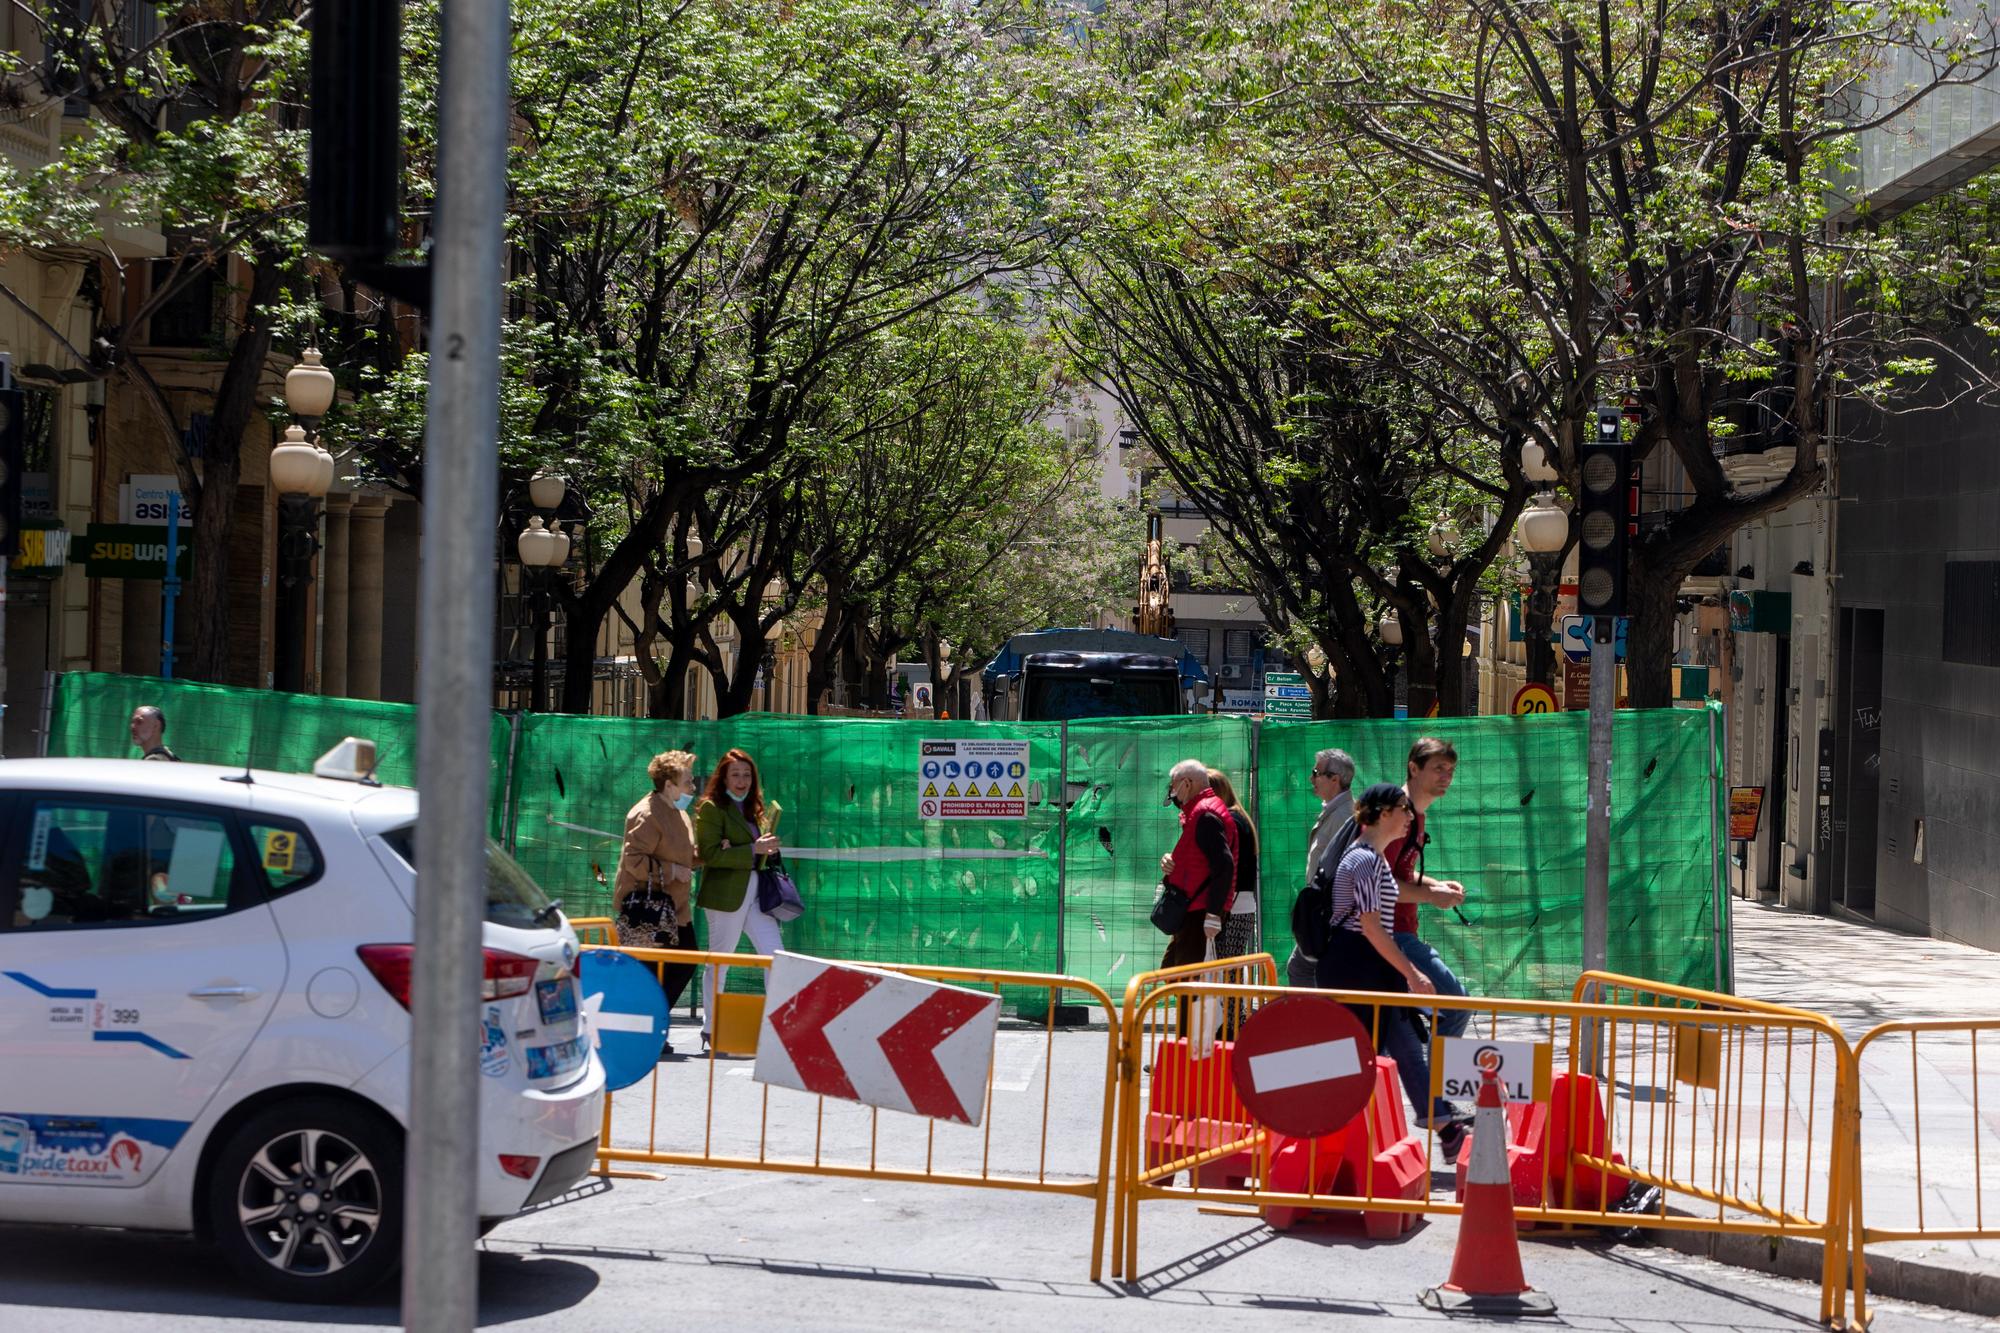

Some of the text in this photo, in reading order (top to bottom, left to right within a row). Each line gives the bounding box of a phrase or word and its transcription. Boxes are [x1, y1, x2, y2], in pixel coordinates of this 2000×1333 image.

[447, 332, 465, 362] 2
[136, 488, 164, 499] Centro
[136, 503, 192, 520] asia
[1523, 699, 1547, 713] 20
[112, 1009, 140, 1023] 399
[1445, 1079, 1529, 1099] SALL
